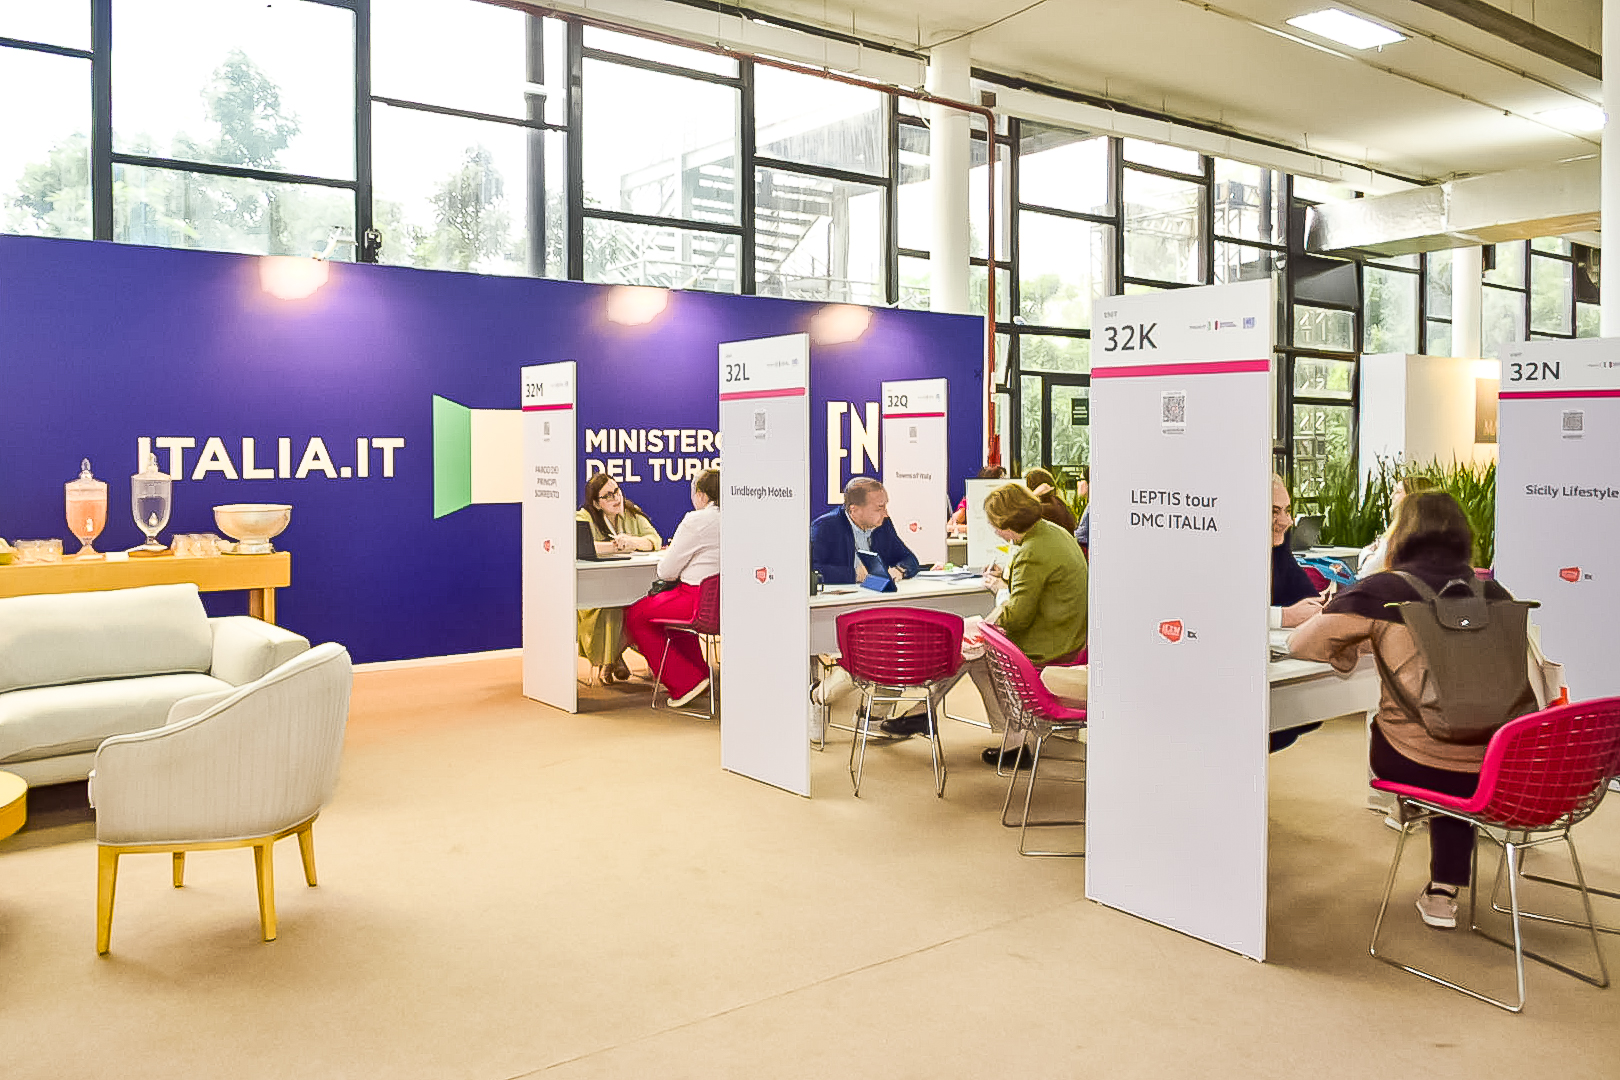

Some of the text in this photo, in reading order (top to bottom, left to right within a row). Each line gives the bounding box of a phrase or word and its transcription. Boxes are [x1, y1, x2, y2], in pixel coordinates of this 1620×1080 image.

[1104, 322, 1158, 352] 32K
[725, 362, 750, 382] 32L
[1509, 361, 1560, 381] 32N
[525, 382, 544, 398] 32M
[887, 394, 908, 408] 32Q
[137, 437, 405, 480] ITALIA.IT
[585, 458, 642, 482] DEL
[731, 485, 793, 500] Lindbergh Hotels
[1131, 490, 1218, 508] LEPTIS tour
[1525, 484, 1619, 501] Sicily Lifestyle
[1130, 512, 1218, 532] DMC ITALIA
